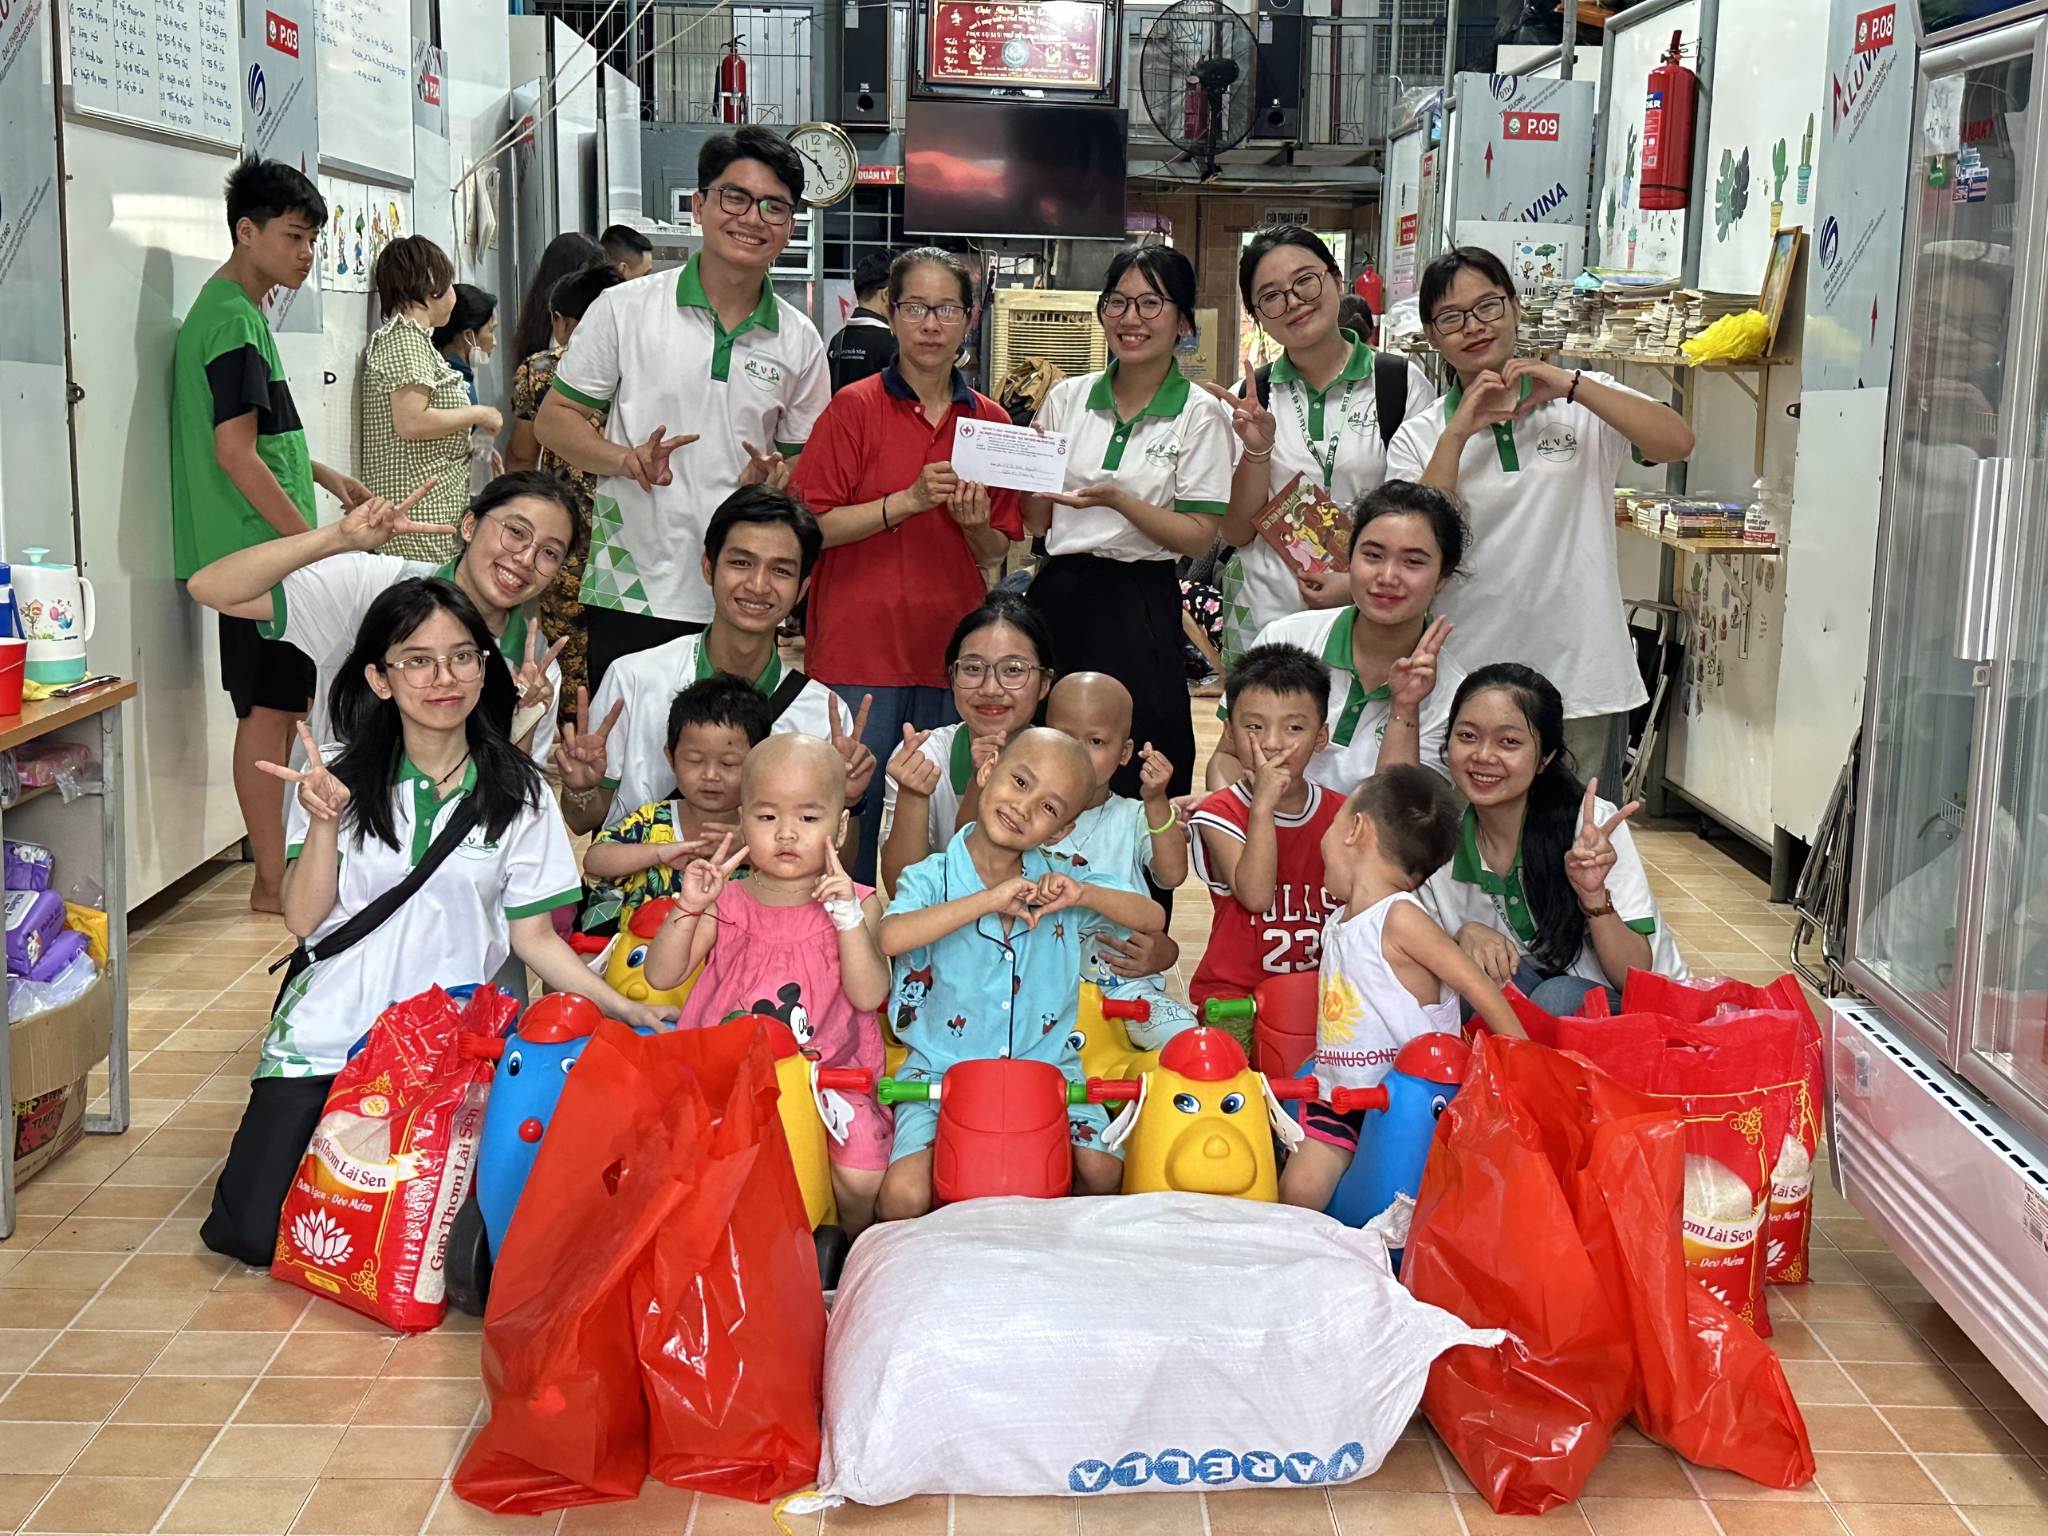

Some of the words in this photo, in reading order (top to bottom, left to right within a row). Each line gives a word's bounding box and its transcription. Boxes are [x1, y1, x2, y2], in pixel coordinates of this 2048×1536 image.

[280, 26, 298, 50] P.03
[1871, 14, 1893, 40] P.08
[1527, 118, 1557, 135] P.09
[811, 135, 820, 145] 12
[1262, 928, 1320, 974] 23
[460, 1108, 480, 1138] Sen
[360, 1171, 386, 1188] Sen
[1730, 1230, 1752, 1243] Sen
[1072, 1448, 1363, 1490] VARELLA
